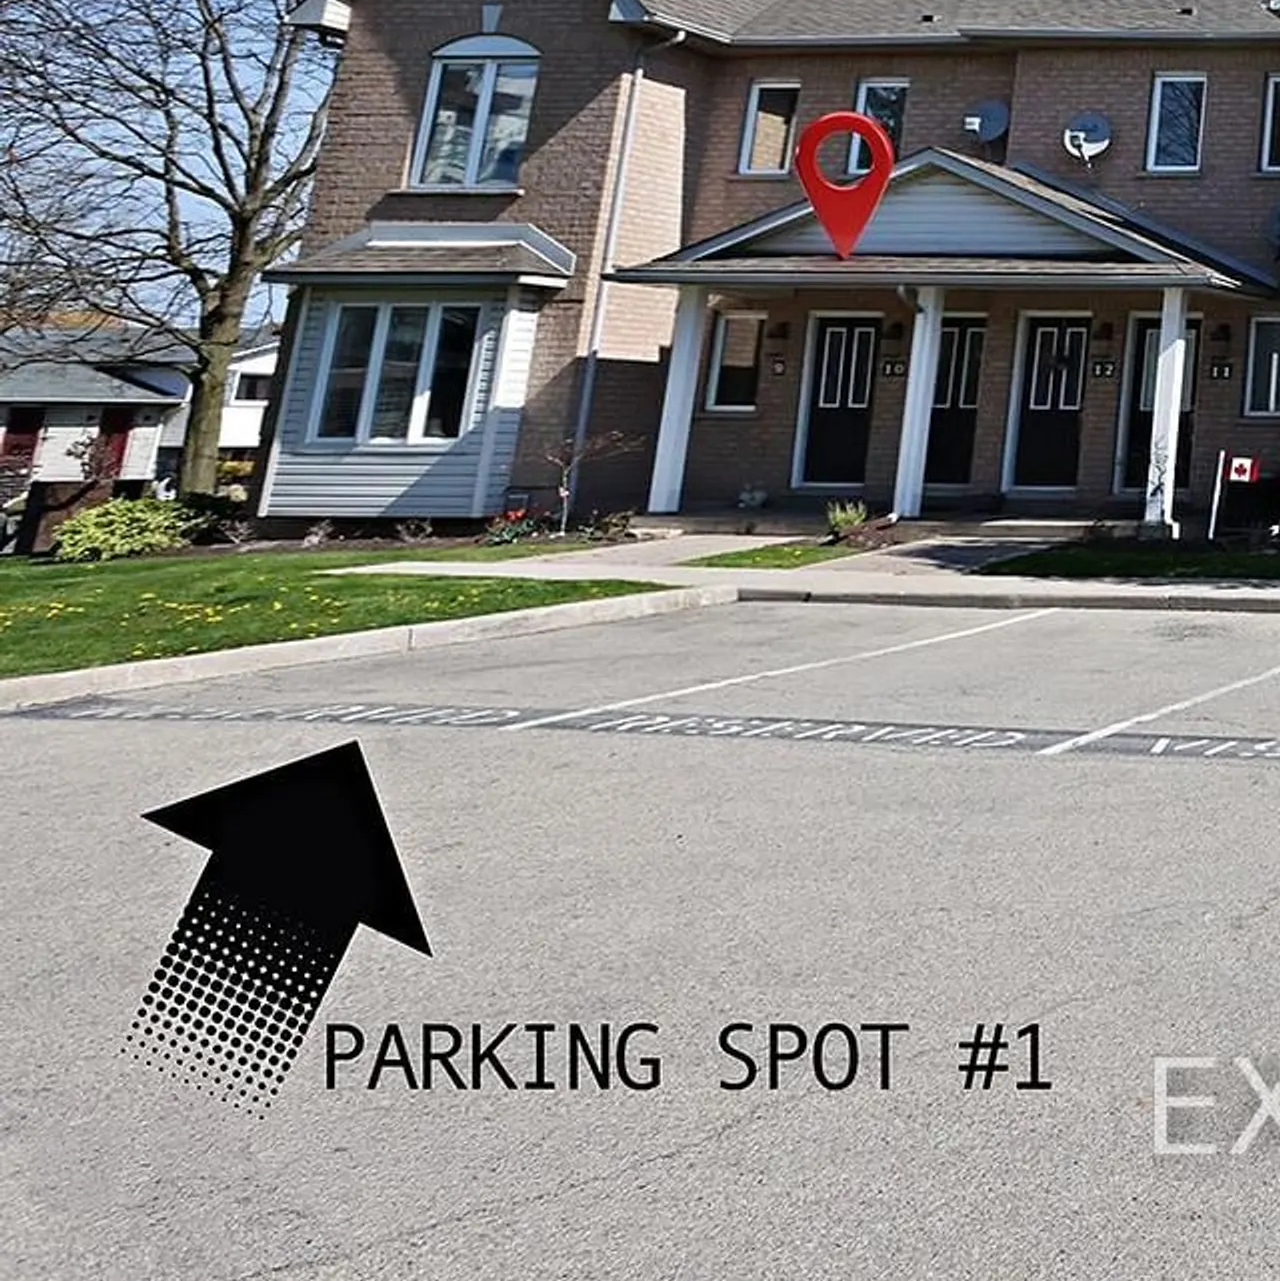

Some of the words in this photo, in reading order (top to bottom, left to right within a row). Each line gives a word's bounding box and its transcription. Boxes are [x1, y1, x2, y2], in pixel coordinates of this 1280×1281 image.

[884, 363, 905, 375] 10
[1094, 364, 1115, 376] 12
[1212, 366, 1230, 378] 11
[586, 715, 1028, 747] RESERVED
